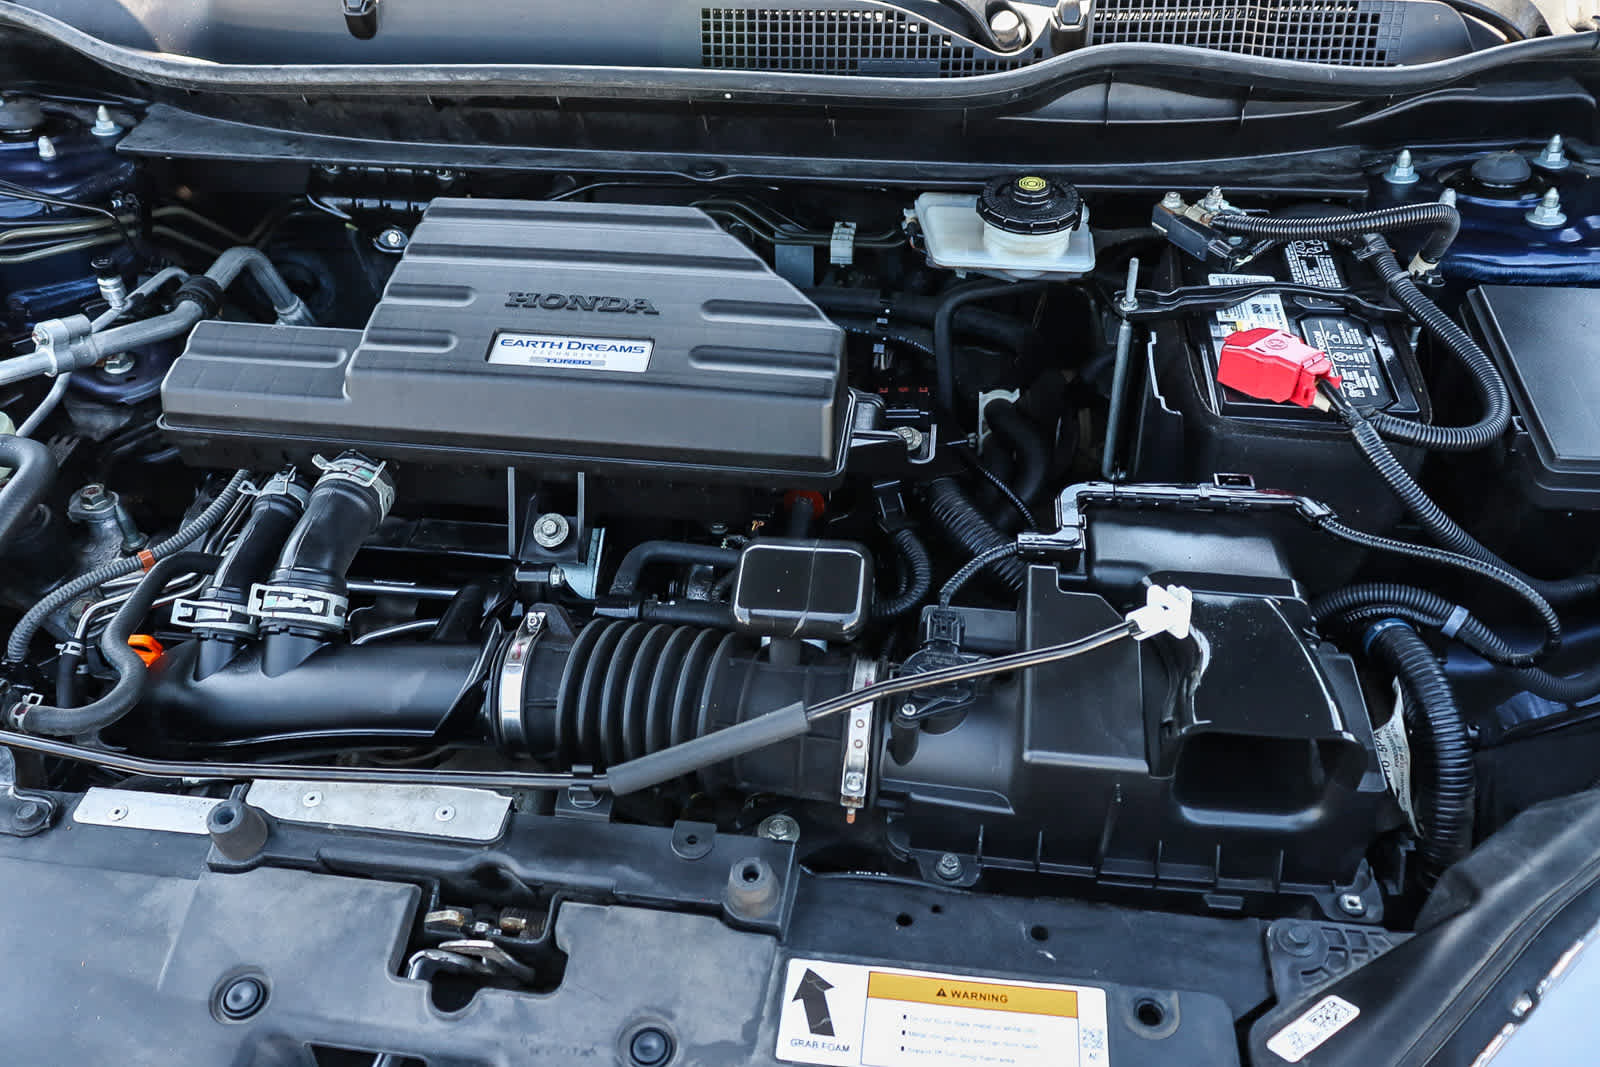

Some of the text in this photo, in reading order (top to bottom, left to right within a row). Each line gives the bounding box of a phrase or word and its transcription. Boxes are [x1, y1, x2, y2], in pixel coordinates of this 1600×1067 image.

[505, 292, 659, 315] HONDA
[501, 338, 646, 354] EARTH DREAMS
[545, 357, 592, 366] TURBO
[950, 989, 1008, 1004] WARNING
[790, 1038, 850, 1052] GRAB FOAM
